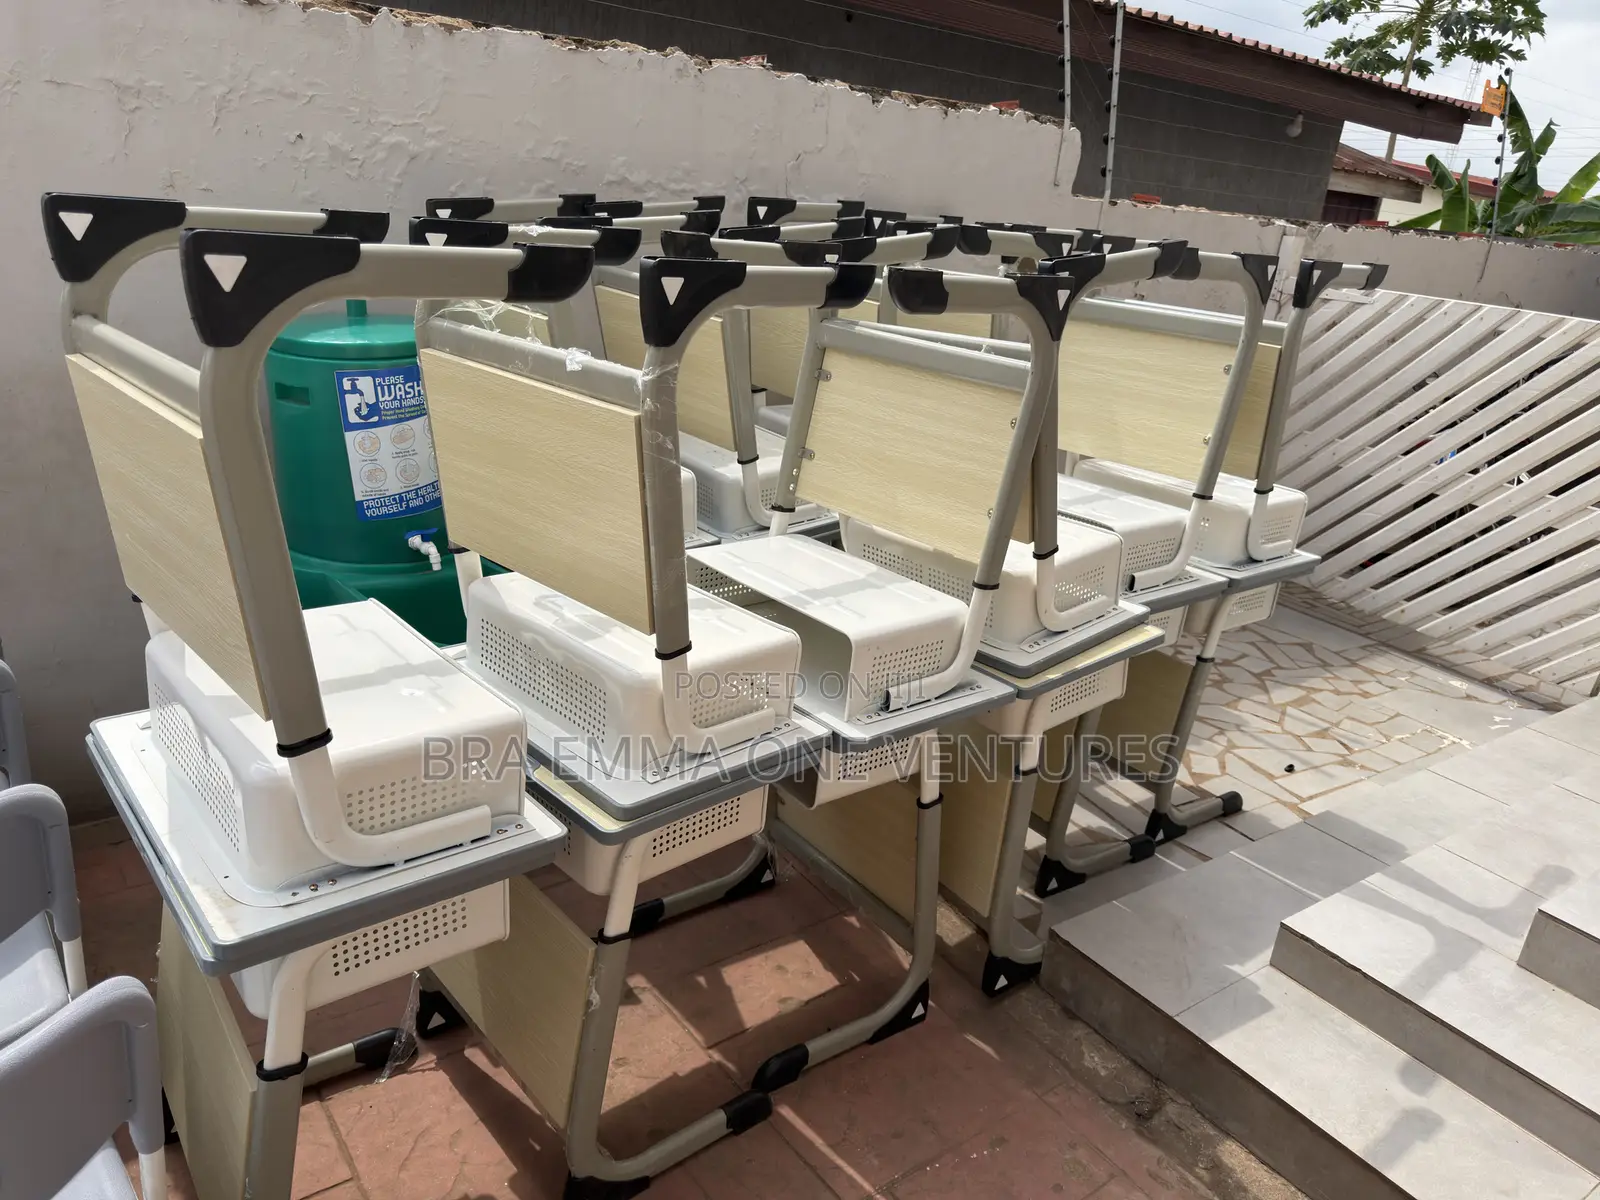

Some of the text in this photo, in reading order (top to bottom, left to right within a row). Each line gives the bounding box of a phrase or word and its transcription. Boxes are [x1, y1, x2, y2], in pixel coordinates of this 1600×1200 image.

[375, 375, 404, 386] PLEASE
[377, 381, 424, 402] WASH
[379, 396, 424, 410] YOUR HANDS
[363, 494, 400, 509] PROTECT
[401, 490, 417, 500] THE
[364, 502, 406, 517] YOURSELF
[409, 498, 424, 508] AND
